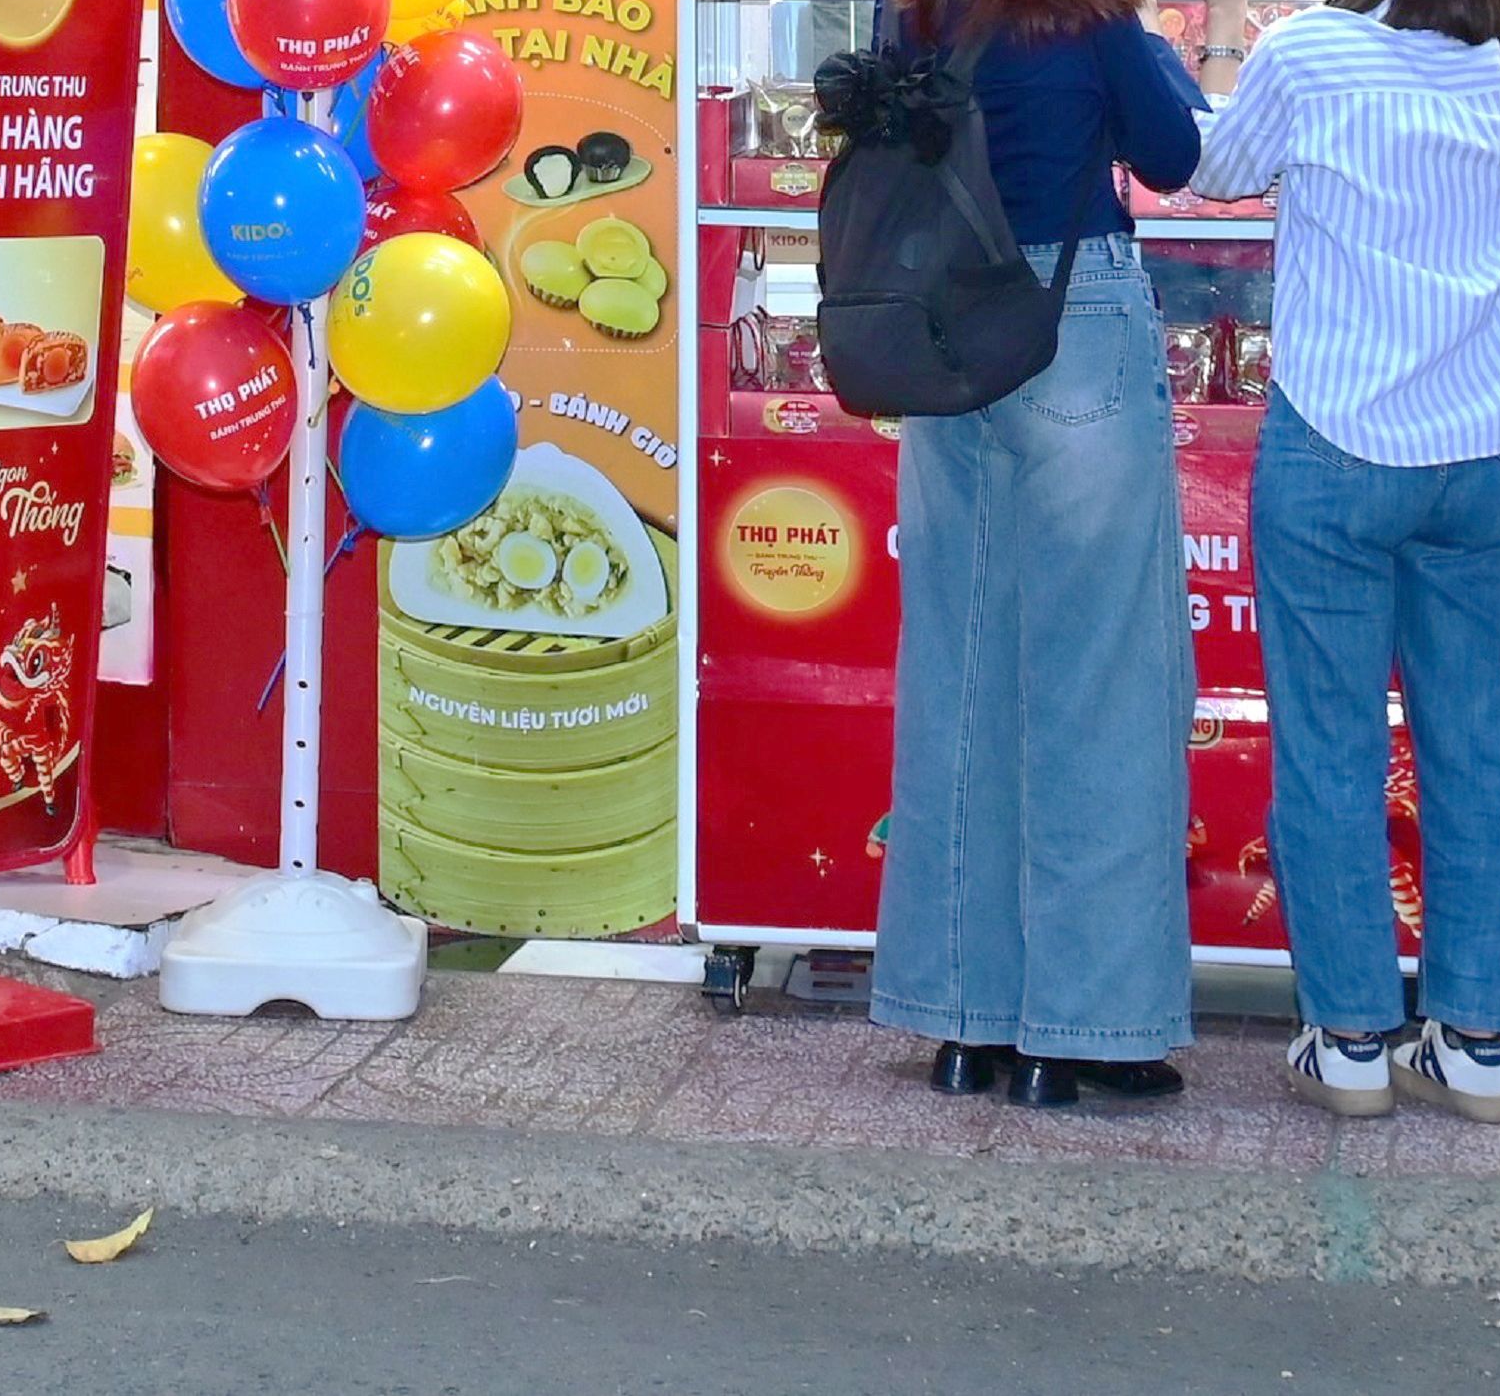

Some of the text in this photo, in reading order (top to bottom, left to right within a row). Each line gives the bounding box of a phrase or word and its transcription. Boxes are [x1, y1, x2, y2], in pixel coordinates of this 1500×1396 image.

[277, 25, 371, 60] THỌ PHÁT
[53, 76, 85, 95] THU
[1, 108, 82, 150] HÀNG
[12, 157, 94, 199] HÃNG
[231, 220, 293, 243] KIDO's
[771, 234, 809, 247] KIDO
[195, 365, 280, 421] THỌ PHÁT
[549, 392, 676, 469] BÁNH GIÒ
[737, 523, 840, 548] THỌ PHÁT
[410, 684, 650, 736] NGUYÊN LIỆU TƯƠI MỚI
